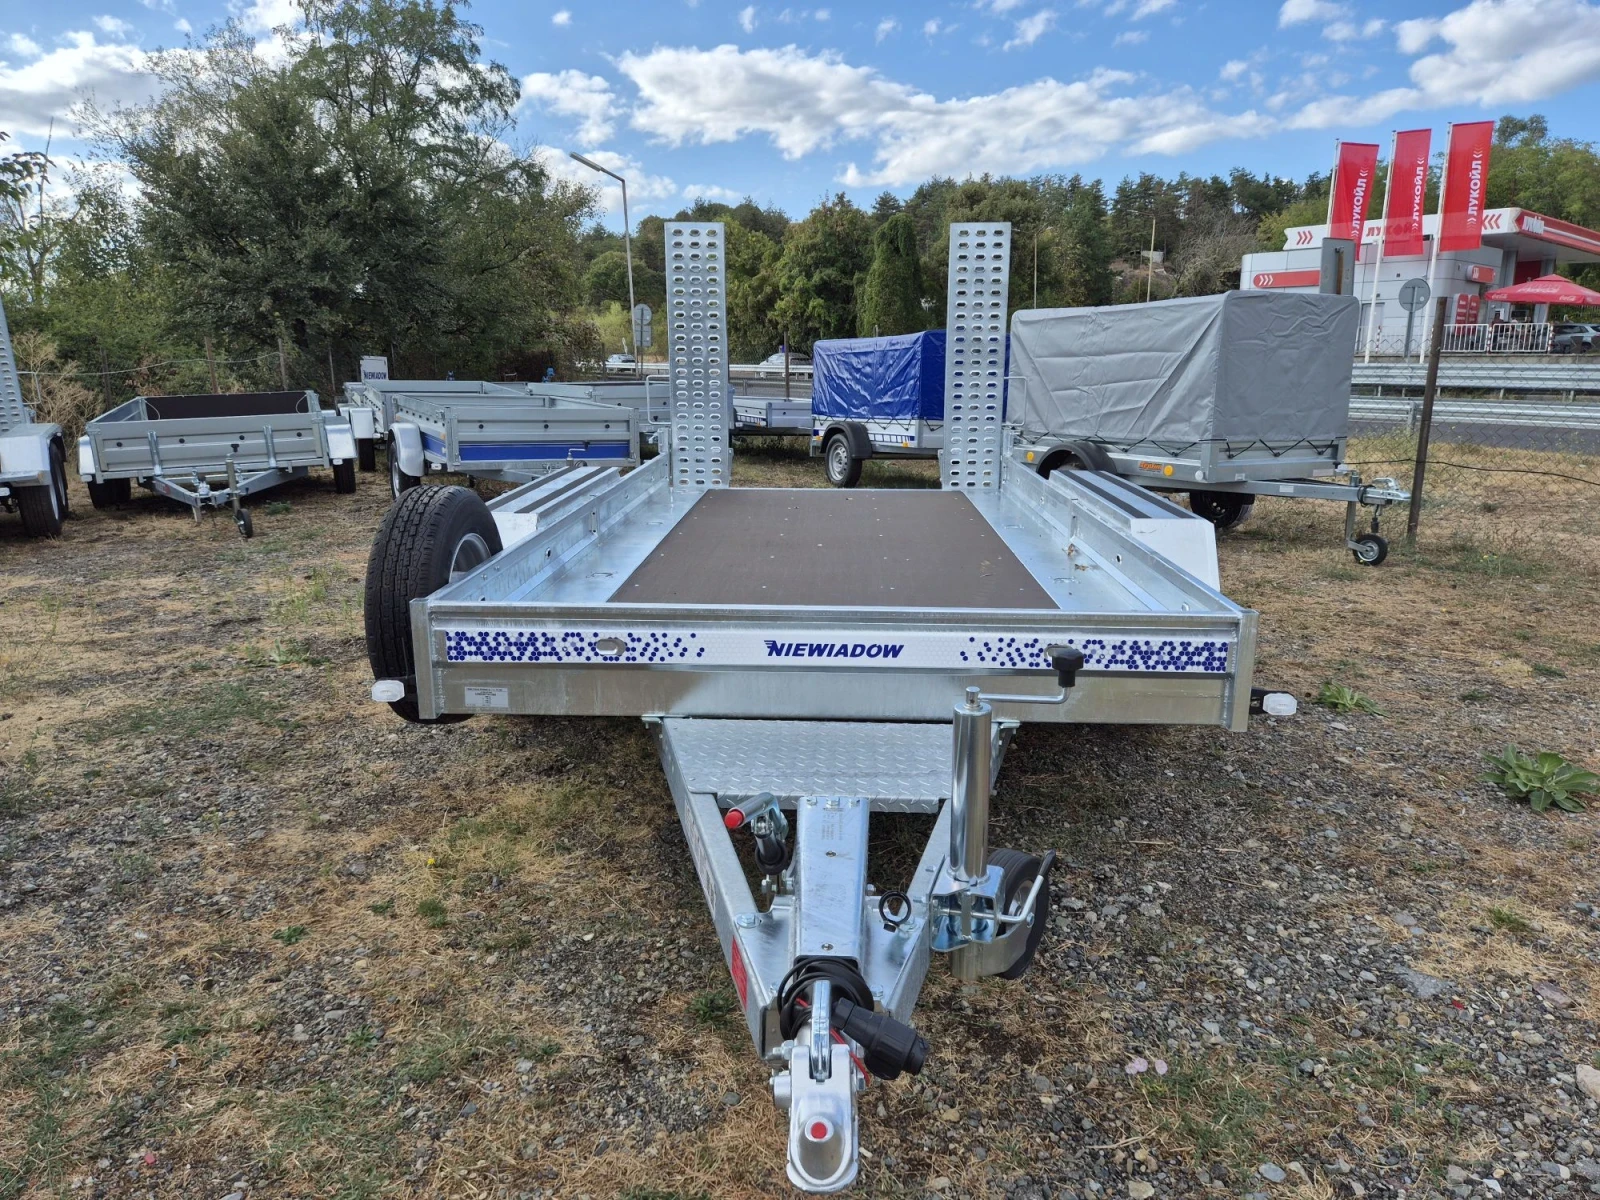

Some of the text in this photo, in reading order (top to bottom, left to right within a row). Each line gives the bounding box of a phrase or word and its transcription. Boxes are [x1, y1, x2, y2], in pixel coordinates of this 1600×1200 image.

[1352, 178, 1367, 229] ЛУКОЙЛ
[1412, 166, 1424, 221] ЛУКОЙЛ
[1467, 160, 1482, 217] ЛУКОЙЛ
